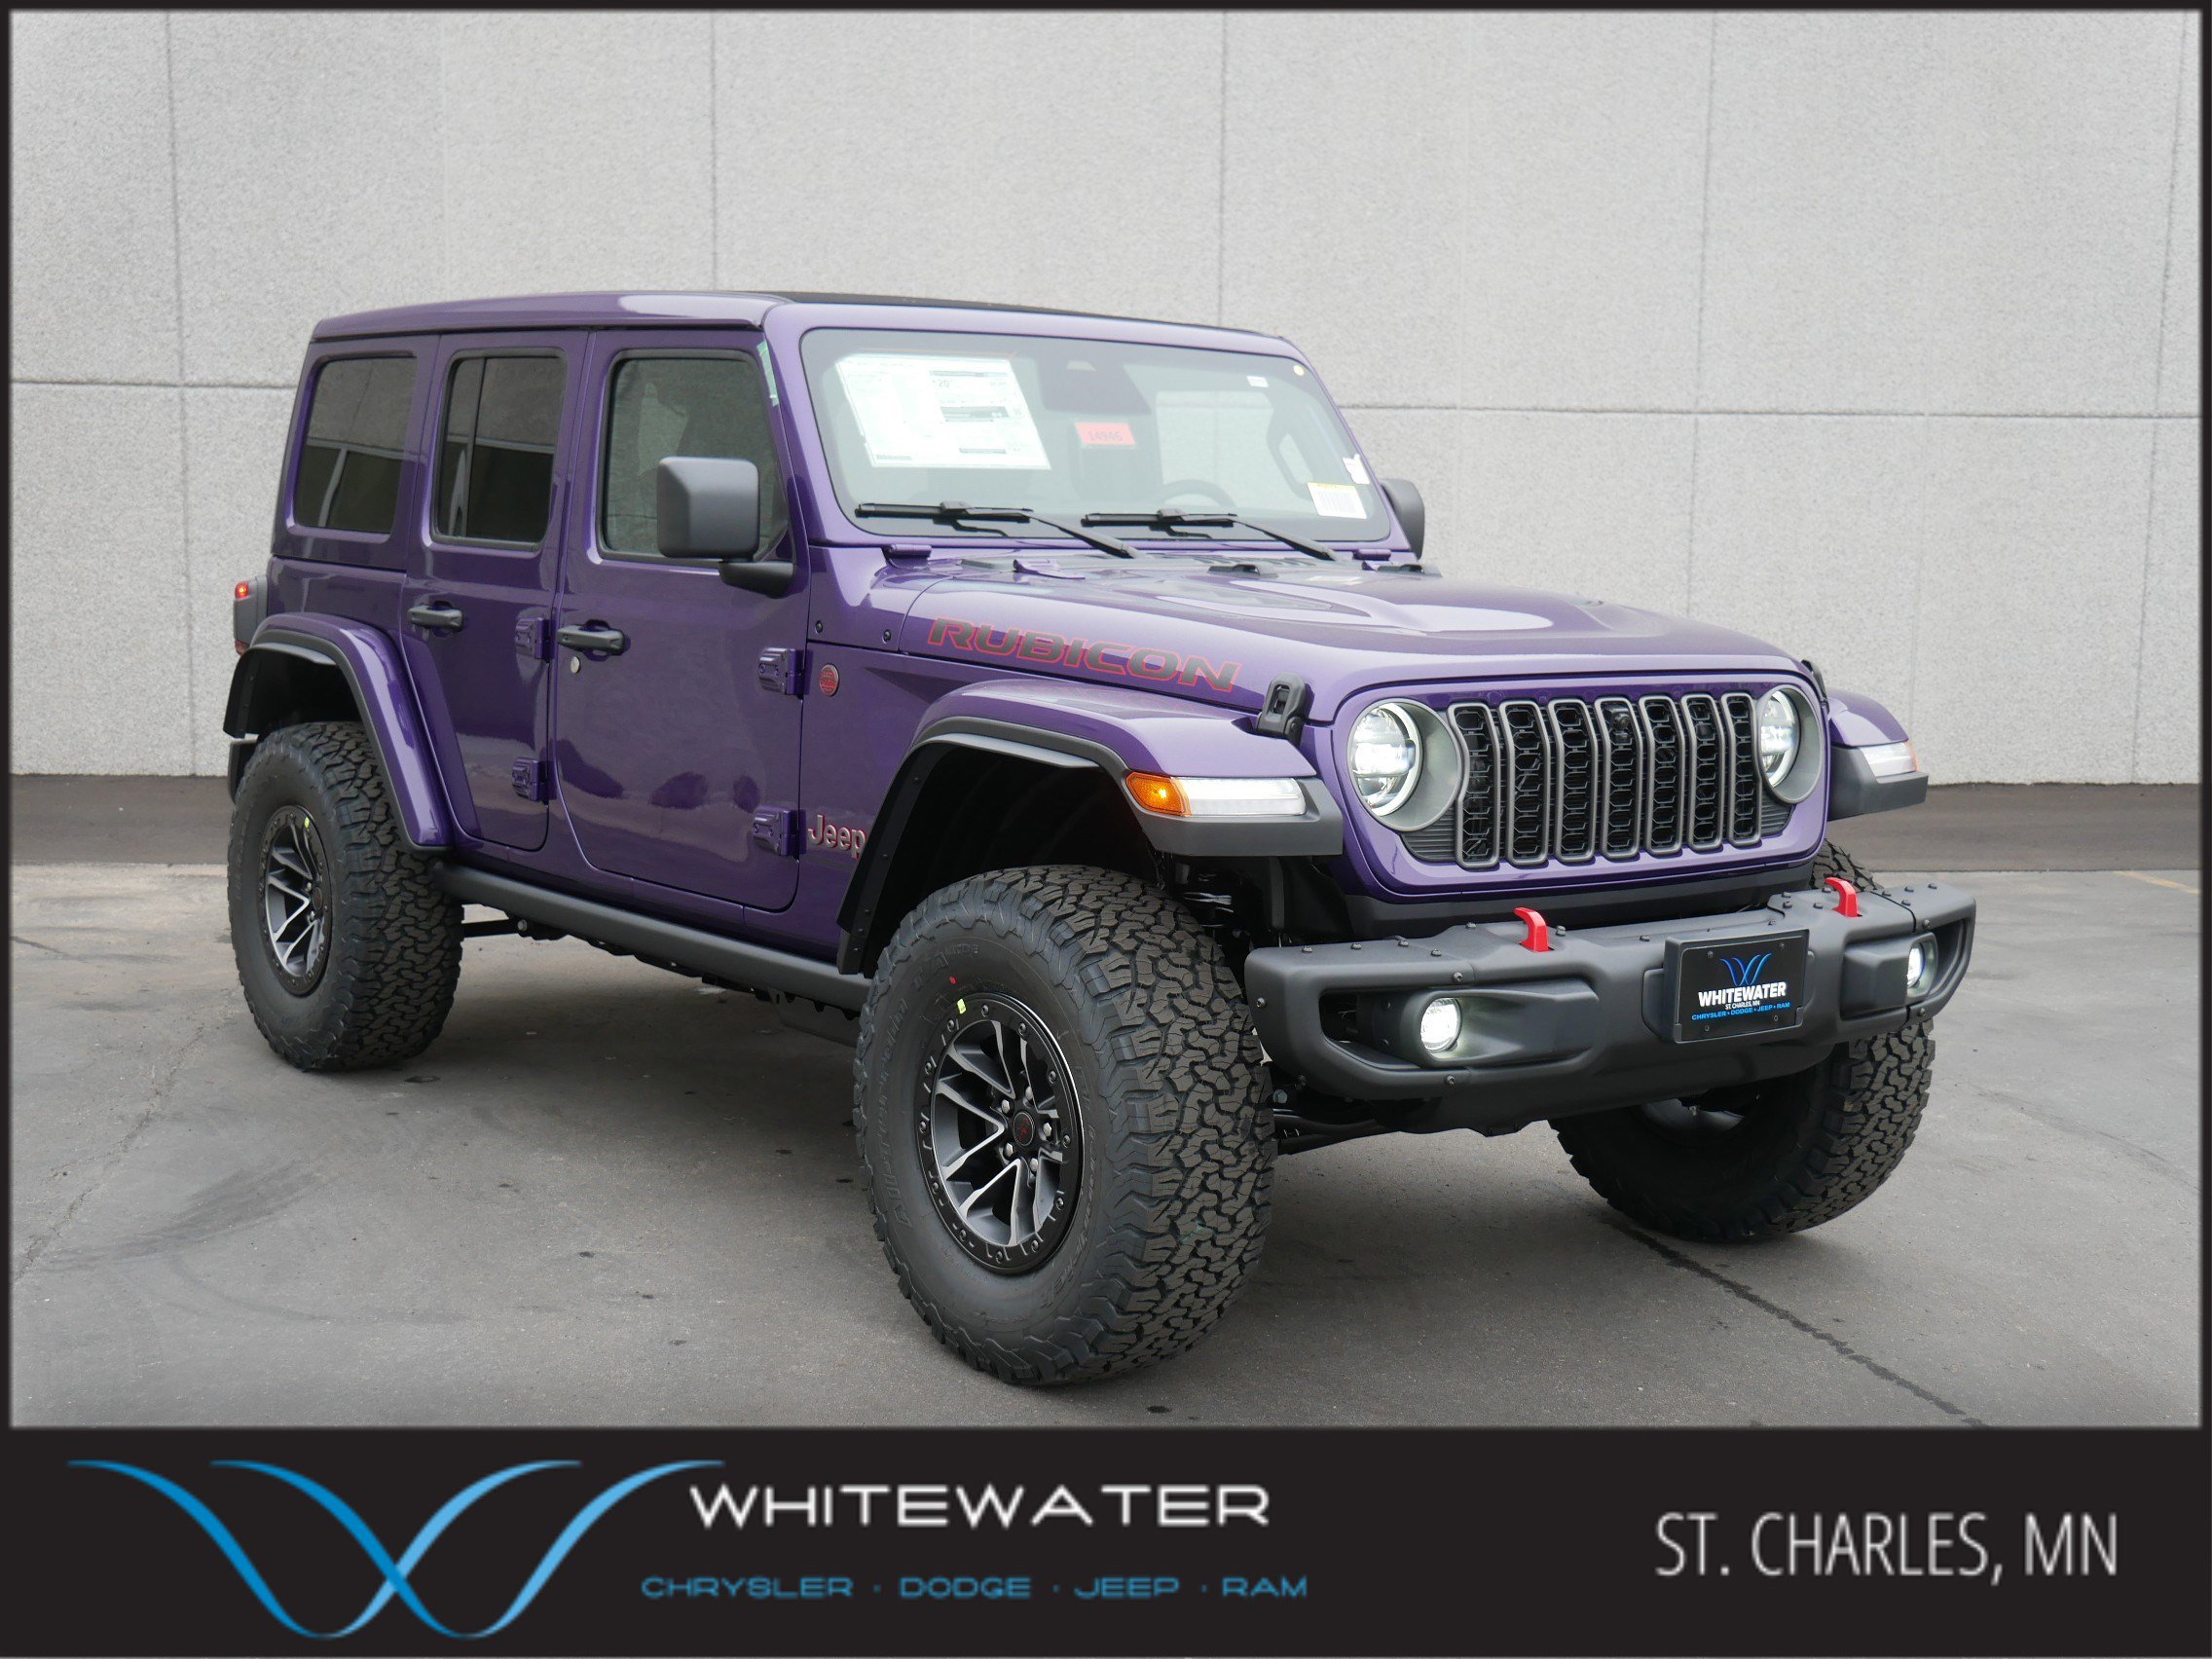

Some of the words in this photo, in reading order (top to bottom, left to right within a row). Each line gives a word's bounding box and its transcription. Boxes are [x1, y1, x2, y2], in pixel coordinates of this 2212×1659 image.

[928, 616, 1242, 693] RUBICON
[808, 814, 866, 860] Jeep
[1691, 1011, 1726, 1020] CHRYSLER
[1730, 1007, 1753, 1015] DODGE
[1756, 1003, 1773, 1013] JEEP
[1698, 981, 1787, 1007] WHITEWATER
